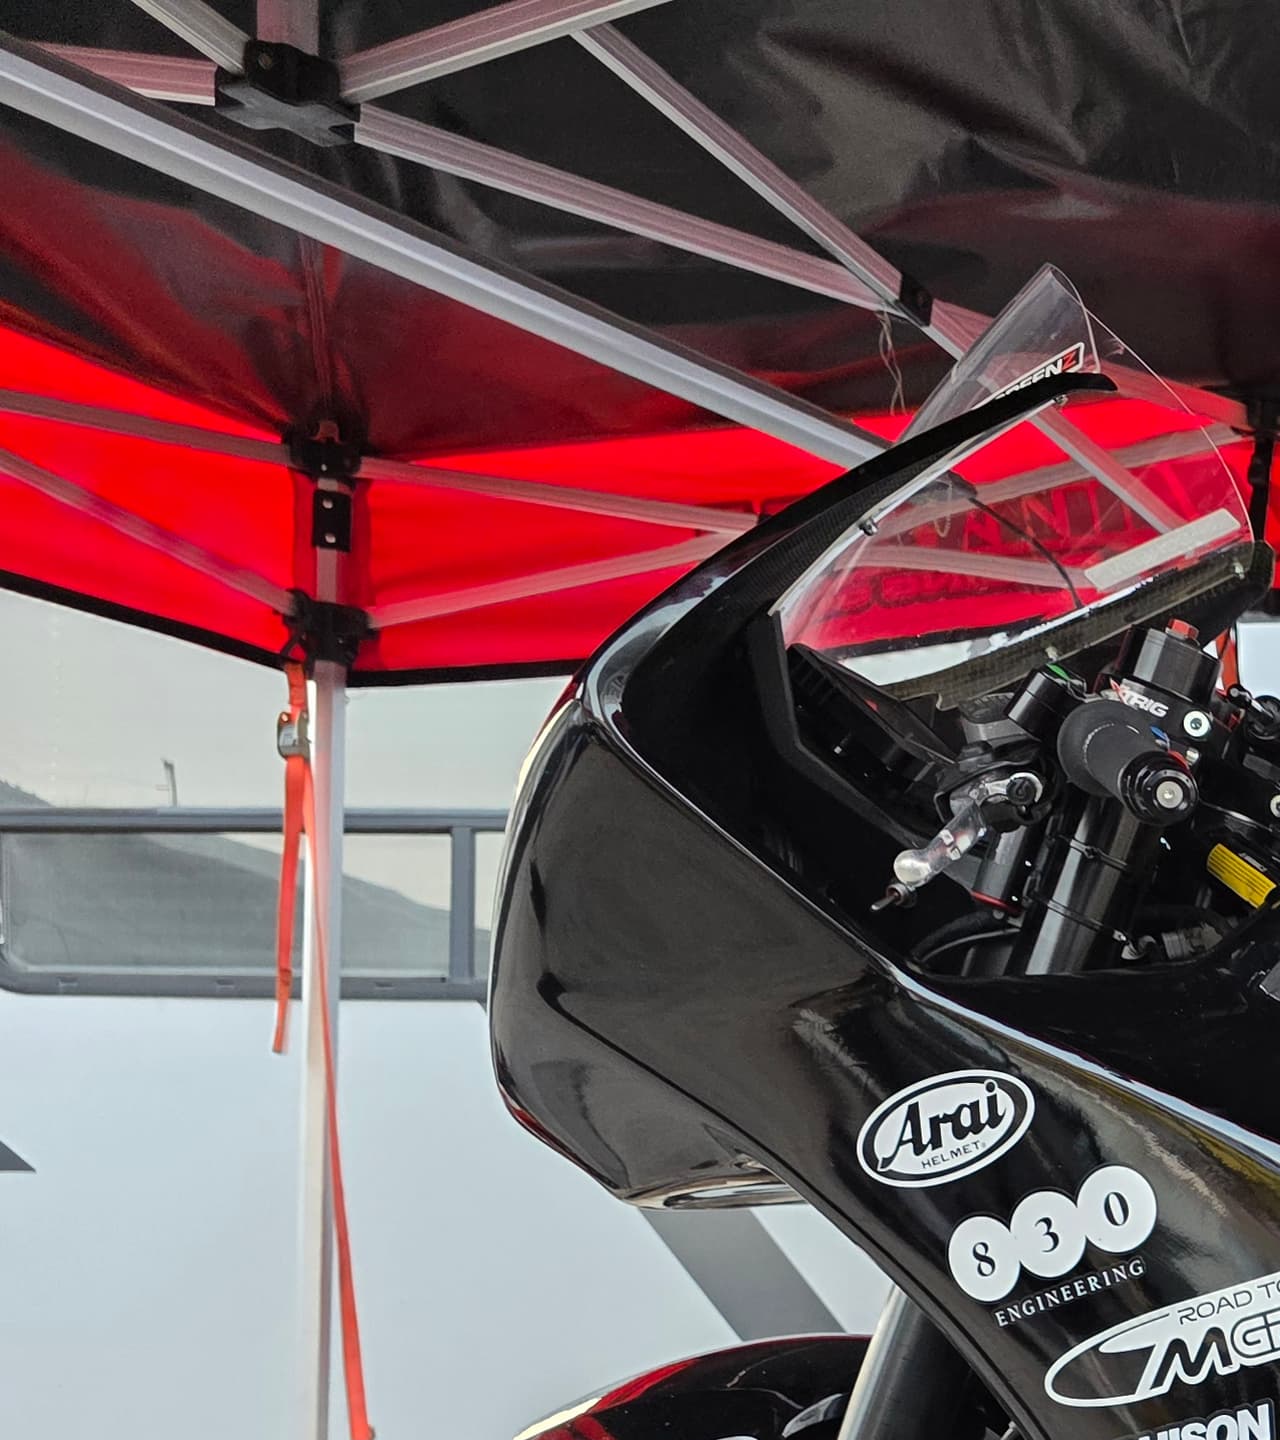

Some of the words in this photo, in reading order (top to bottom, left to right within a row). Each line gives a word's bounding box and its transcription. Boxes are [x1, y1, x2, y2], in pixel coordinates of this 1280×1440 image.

[878, 1079, 1006, 1170] Arai
[920, 1140, 981, 1170] HELMET
[972, 1191, 1130, 1278] 830
[994, 1258, 1145, 1328] ENGINEERING
[1177, 1290, 1253, 1326] ROAD
